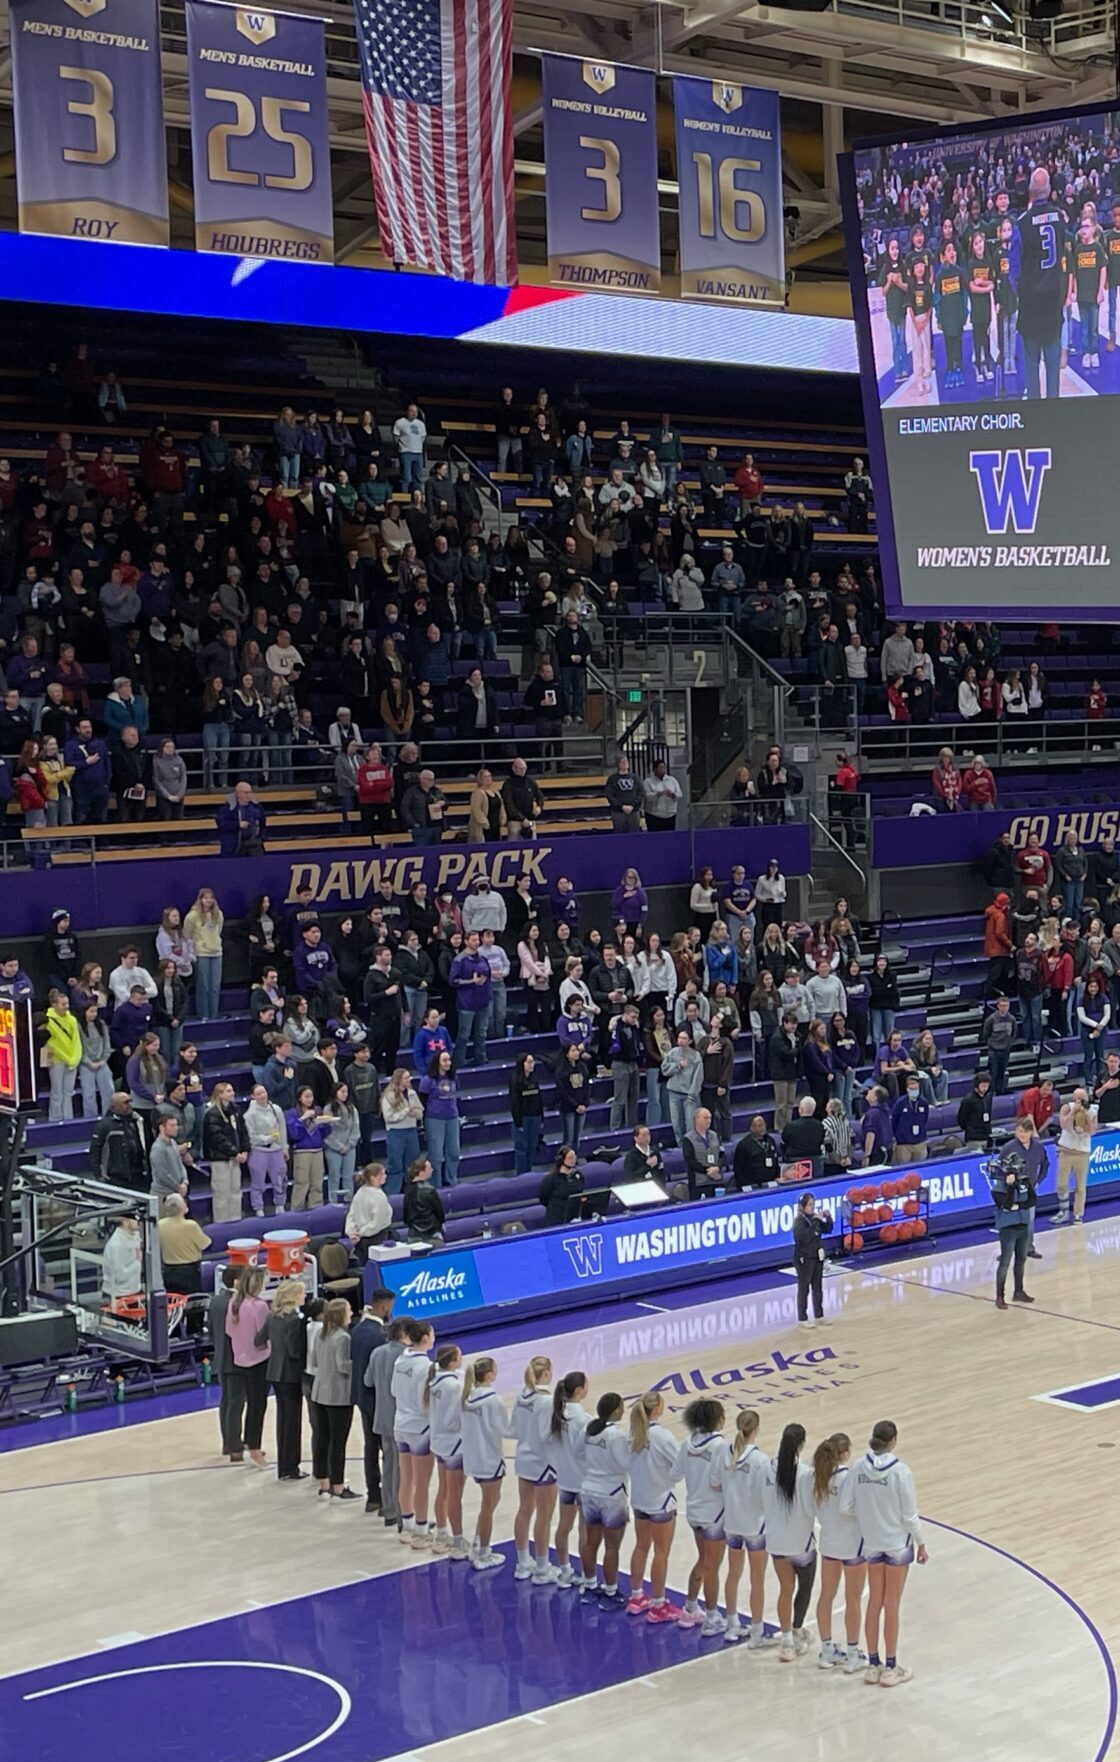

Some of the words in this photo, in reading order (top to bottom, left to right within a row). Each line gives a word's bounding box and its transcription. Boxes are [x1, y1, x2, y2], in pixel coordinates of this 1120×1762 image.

[23, 20, 62, 37] MEN'S
[64, 27, 149, 51] BASKETBALL
[247, 15, 265, 31] W
[200, 49, 236, 64] MEN'S
[238, 54, 315, 77] BASKETBALL
[59, 65, 117, 166] 3
[552, 98, 592, 115] WOMEN'S
[594, 104, 647, 122] VOLLEYBALL
[204, 87, 314, 191] 25
[684, 119, 719, 133] WOMEN'S
[722, 124, 772, 140] VOLLEYBALL
[579, 135, 622, 222] 3
[692, 152, 766, 243] 16
[72, 217, 118, 238] ROY
[211, 233, 320, 259] HOUBREGS
[558, 264, 649, 288] THOMPSON
[696, 280, 770, 300] VANSANT
[899, 415, 978, 434] ELEMENTARY
[969, 448, 1052, 534] W
[917, 546, 991, 567] WOMEN'S
[994, 545, 1110, 567] BASKETBALL
[693, 650, 707, 687] 2
[1009, 815, 1049, 848] GO
[284, 856, 424, 904] DAWG
[435, 847, 552, 895] PACK
[563, 1234, 603, 1278] W
[616, 1211, 757, 1264] WASHINGTON
[399, 1268, 467, 1297] Alaska
[407, 1289, 464, 1308] AIRLINES
[621, 1346, 838, 1409] Alaska
[736, 1378, 853, 1411] ARENA
